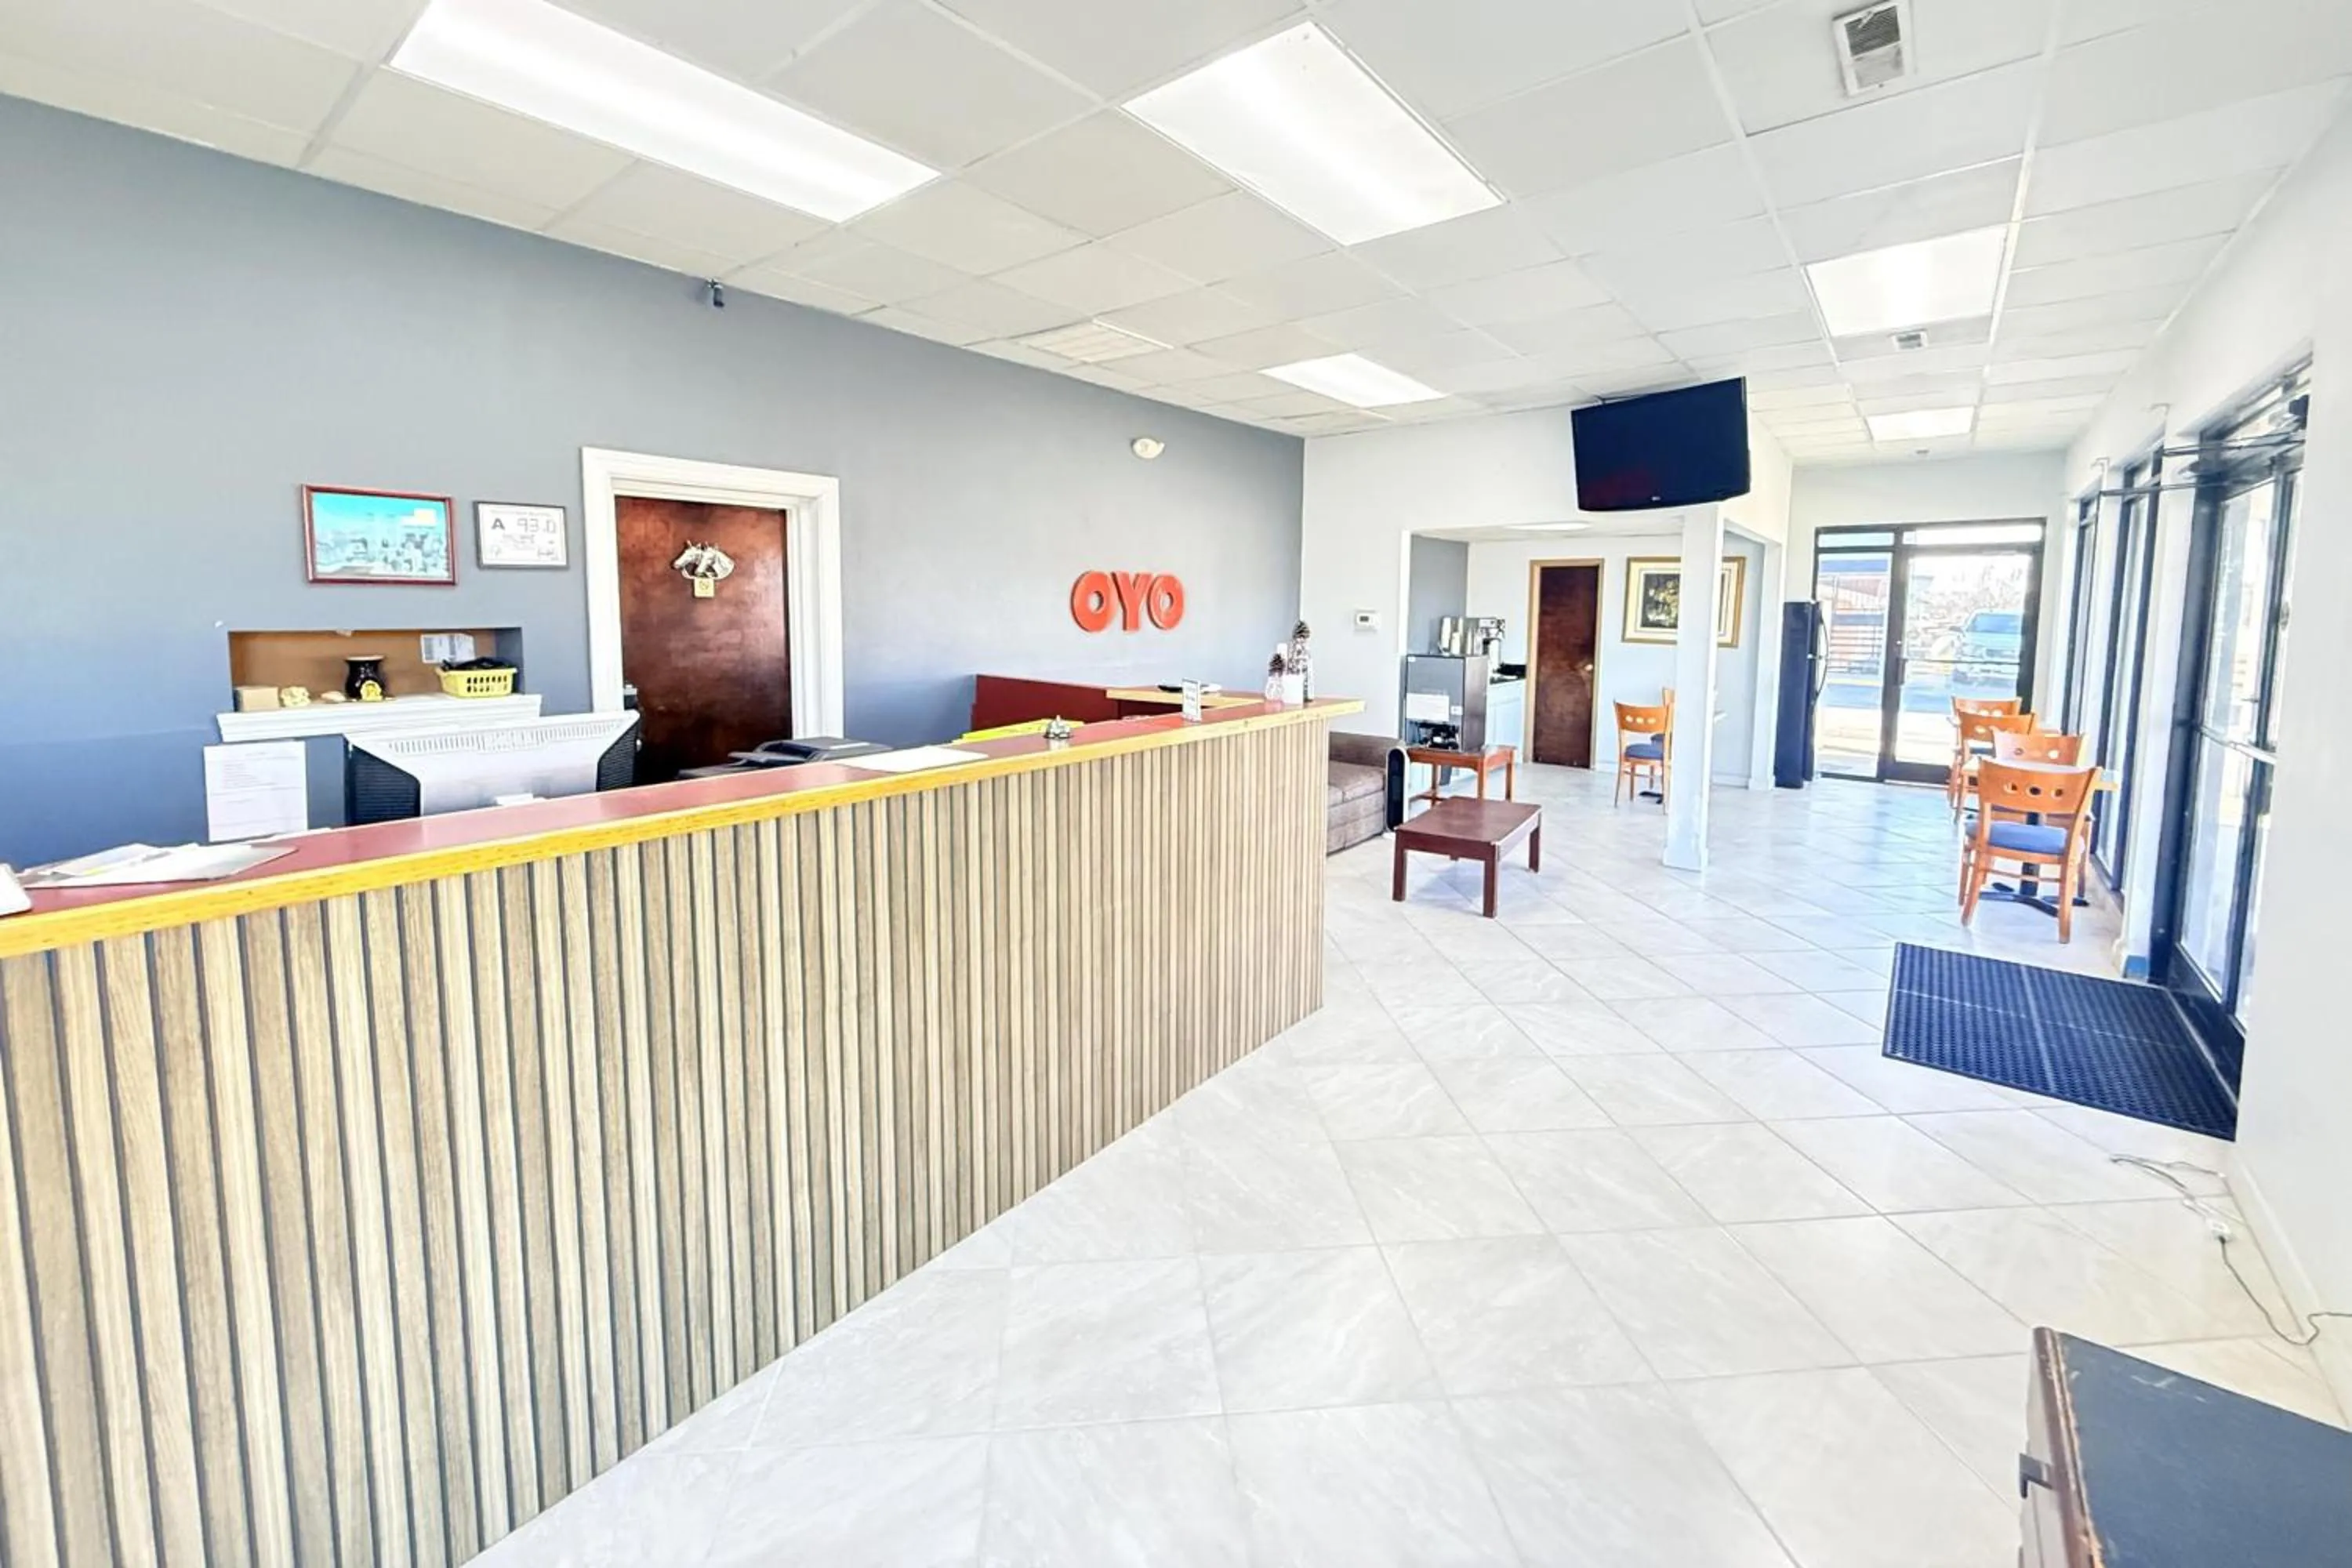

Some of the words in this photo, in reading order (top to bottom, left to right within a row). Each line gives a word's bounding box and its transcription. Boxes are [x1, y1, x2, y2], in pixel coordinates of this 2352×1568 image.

[491, 517, 506, 530] A
[517, 518, 557, 534] 93.0
[1071, 570, 1184, 633] OYO
